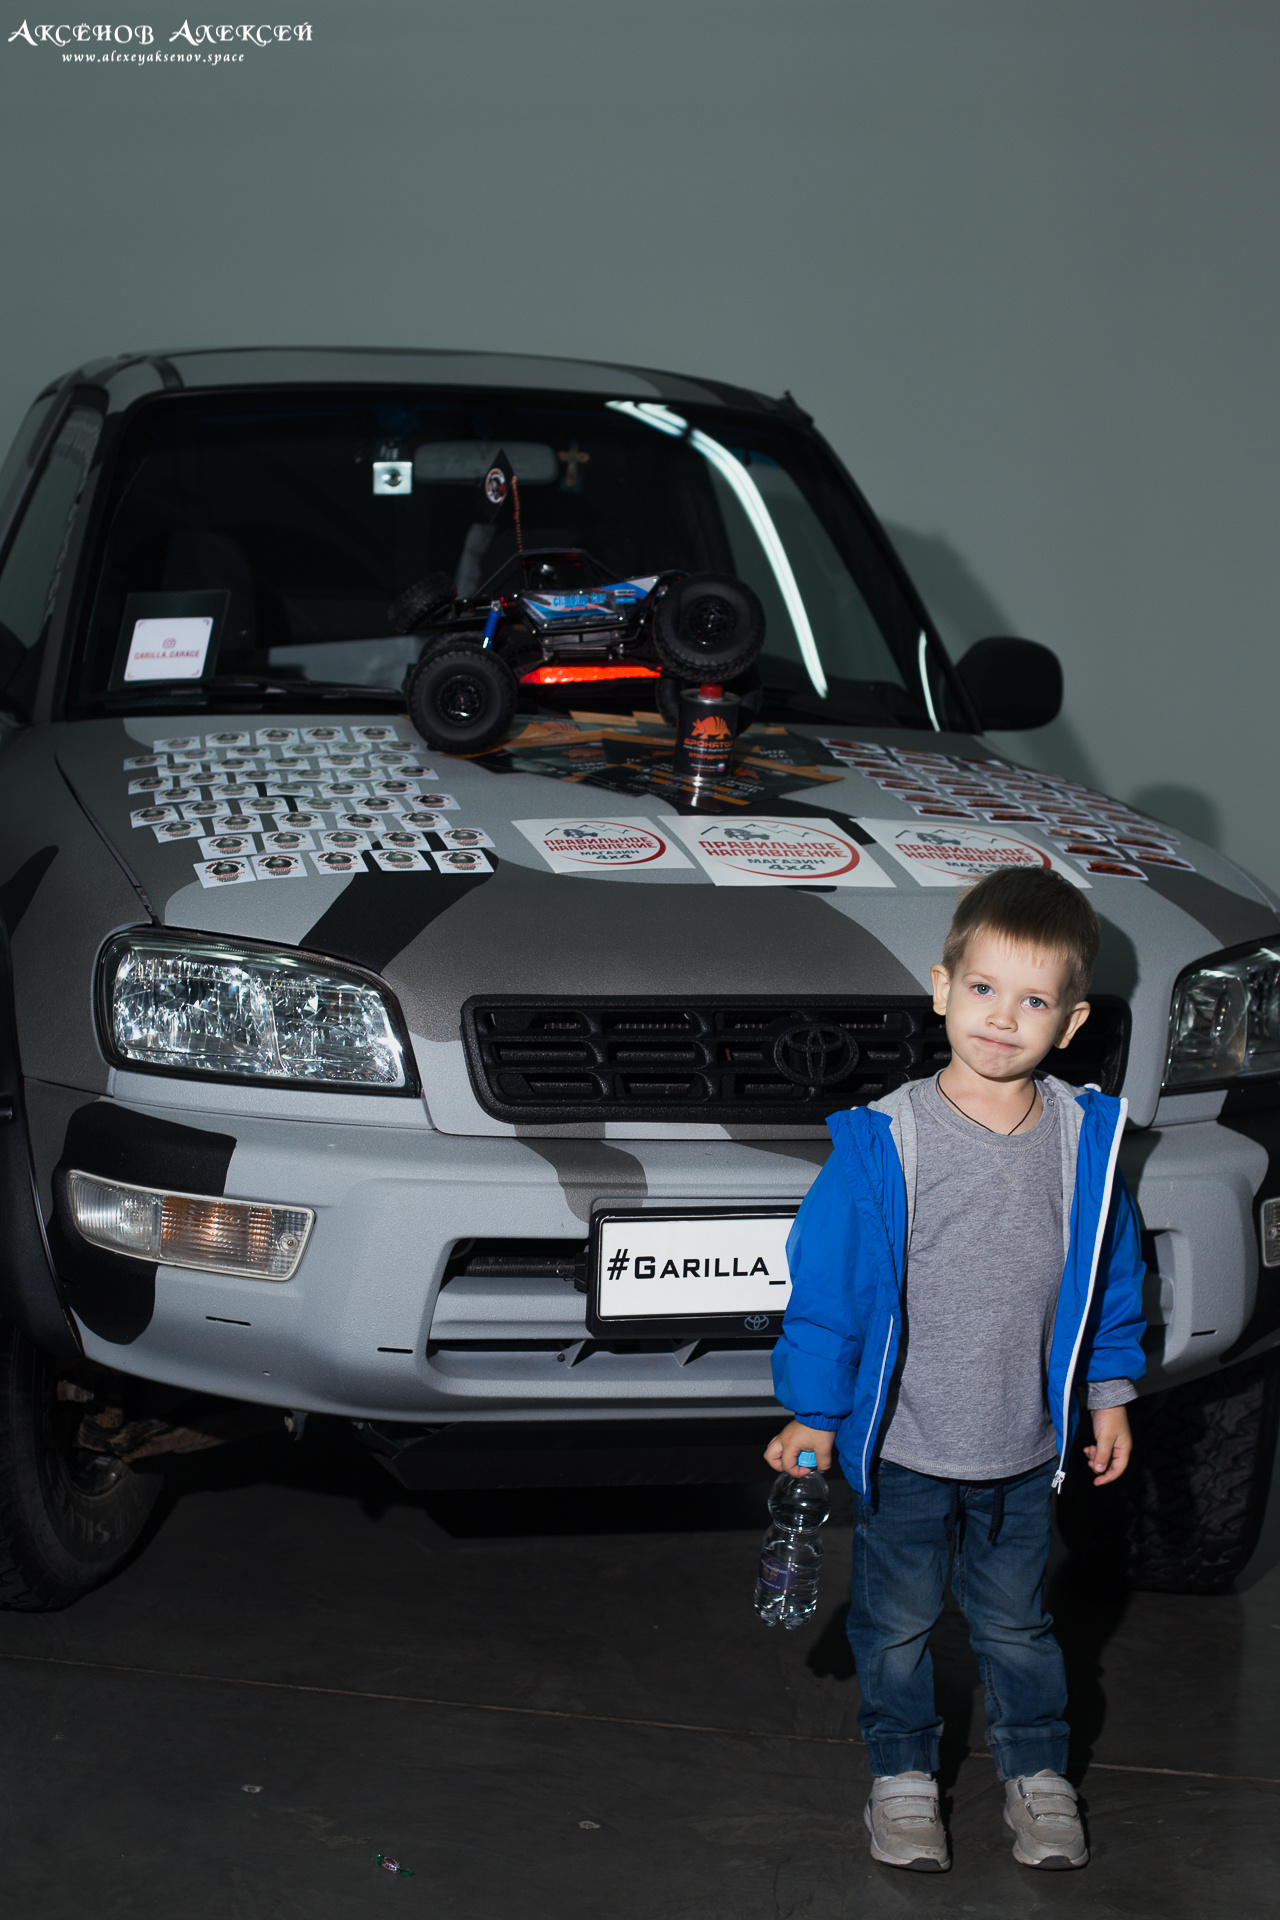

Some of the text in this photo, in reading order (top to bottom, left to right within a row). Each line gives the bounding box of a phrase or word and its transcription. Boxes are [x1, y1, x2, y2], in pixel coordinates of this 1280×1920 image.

[543, 836, 652, 847] ПРАВИЛЬНОЕ
[698, 840, 841, 850] ПРАВИЛЬНОЕ
[547, 842, 657, 852] НАПРАВЛЕНИЕ
[895, 843, 1031, 856] ПРАВИЛЬНОЕ
[704, 848, 848, 858] НАПРАВЛЕНИЕ
[903, 851, 1040, 863] НАПРАВЛЕНИЕ
